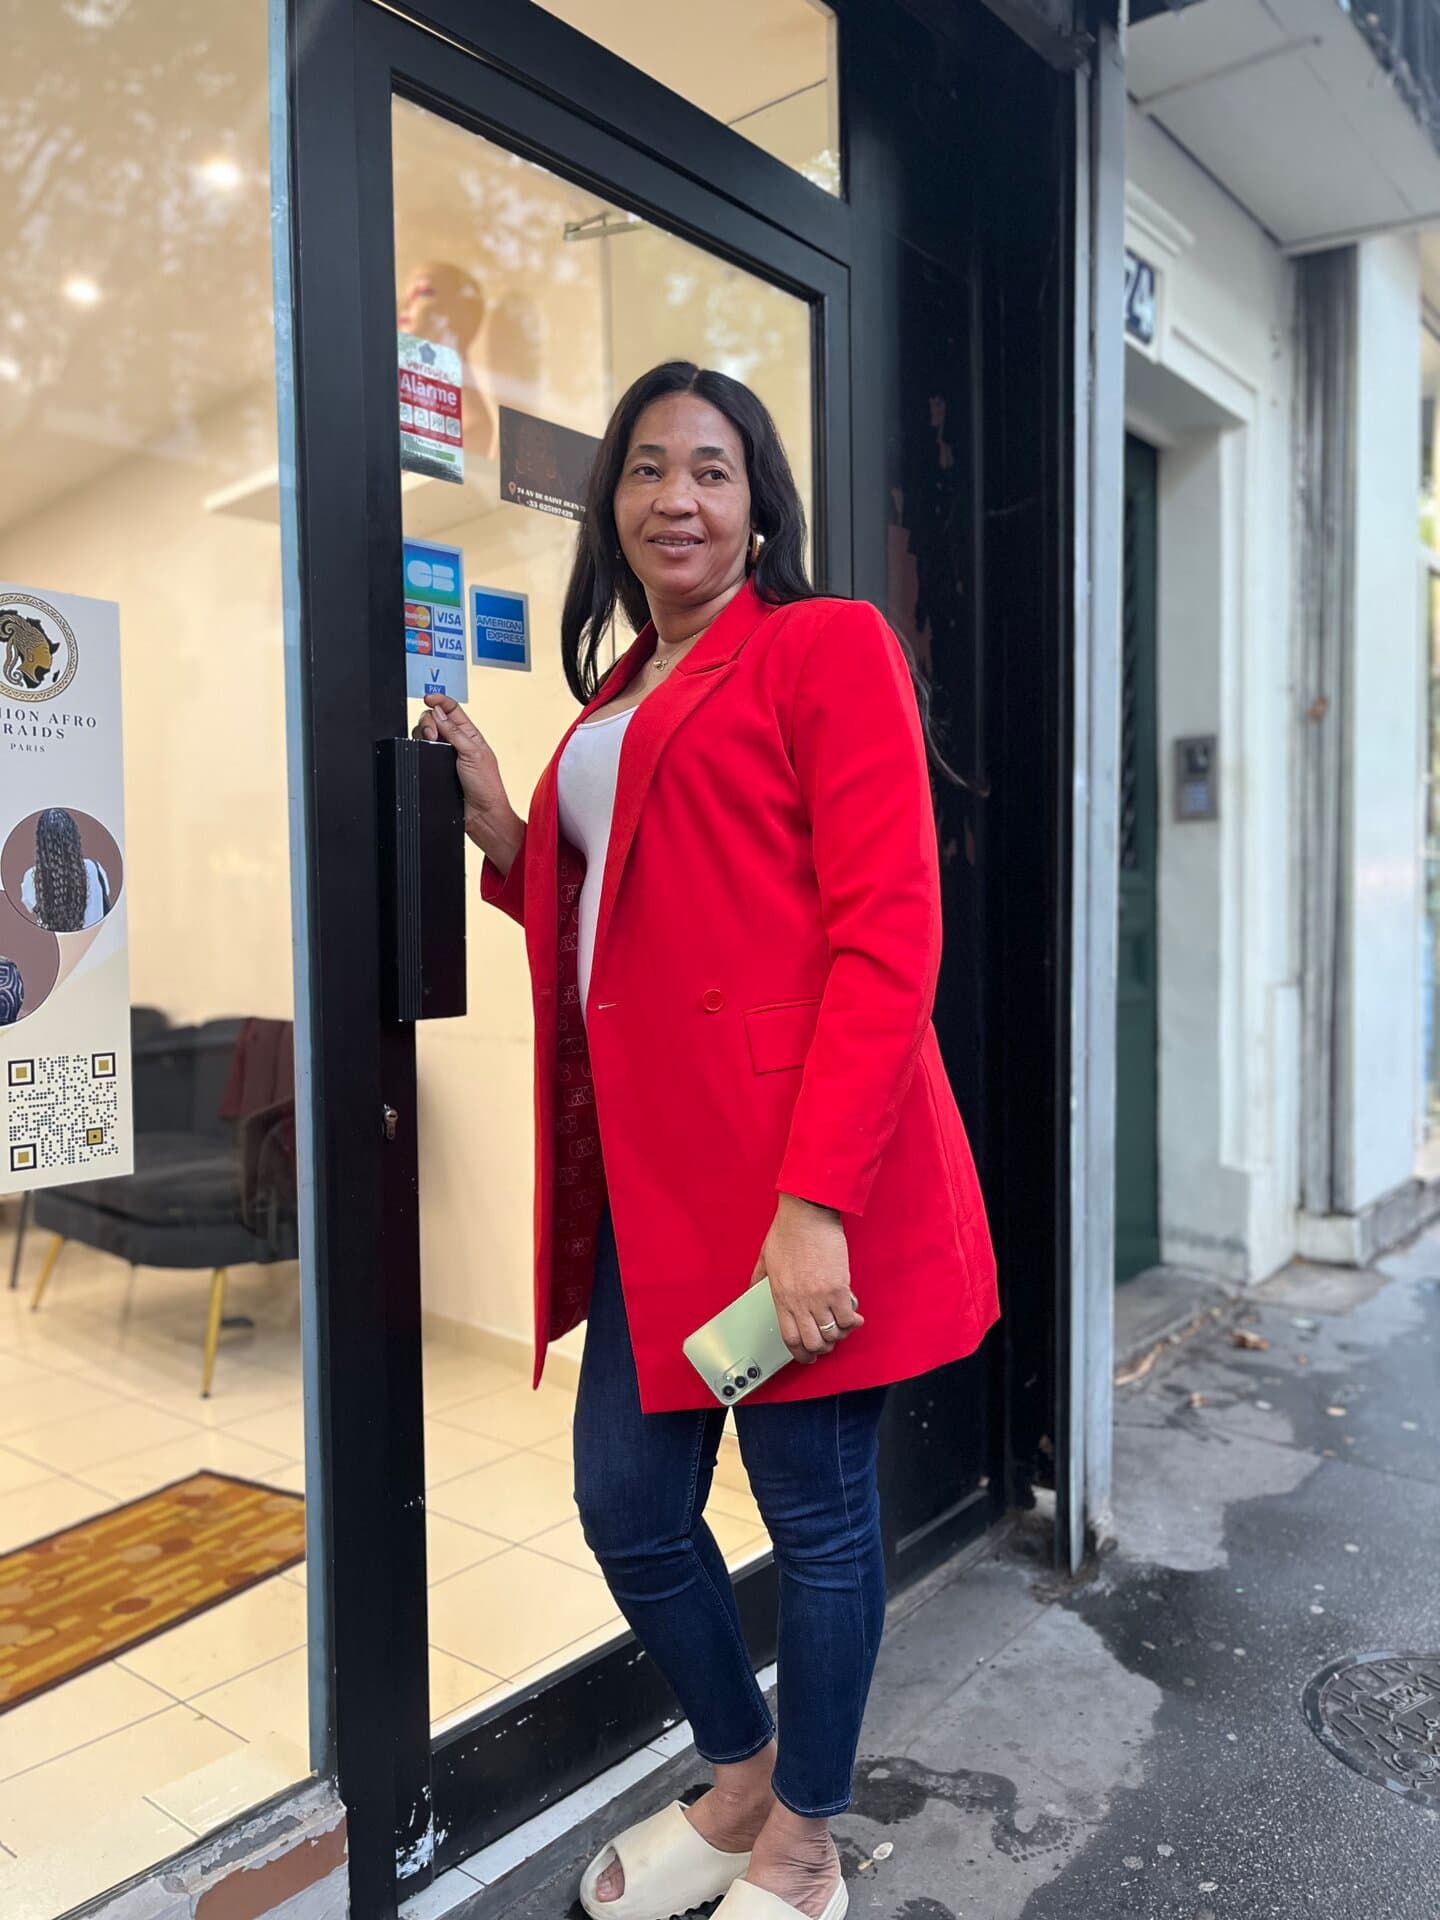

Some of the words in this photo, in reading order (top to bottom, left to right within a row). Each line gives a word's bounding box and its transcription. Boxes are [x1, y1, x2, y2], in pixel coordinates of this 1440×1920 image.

[401, 373, 457, 405] Alarme
[407, 560, 455, 592] CB
[437, 610, 461, 626] VISA
[477, 616, 523, 633] AMERICAN
[437, 636, 463, 652] VISA
[487, 630, 525, 645] EXPRESS
[430, 668, 440, 682] V
[0, 706, 40, 722] ION
[49, 712, 97, 729] AFRO
[10, 743, 46, 752] PARIS
